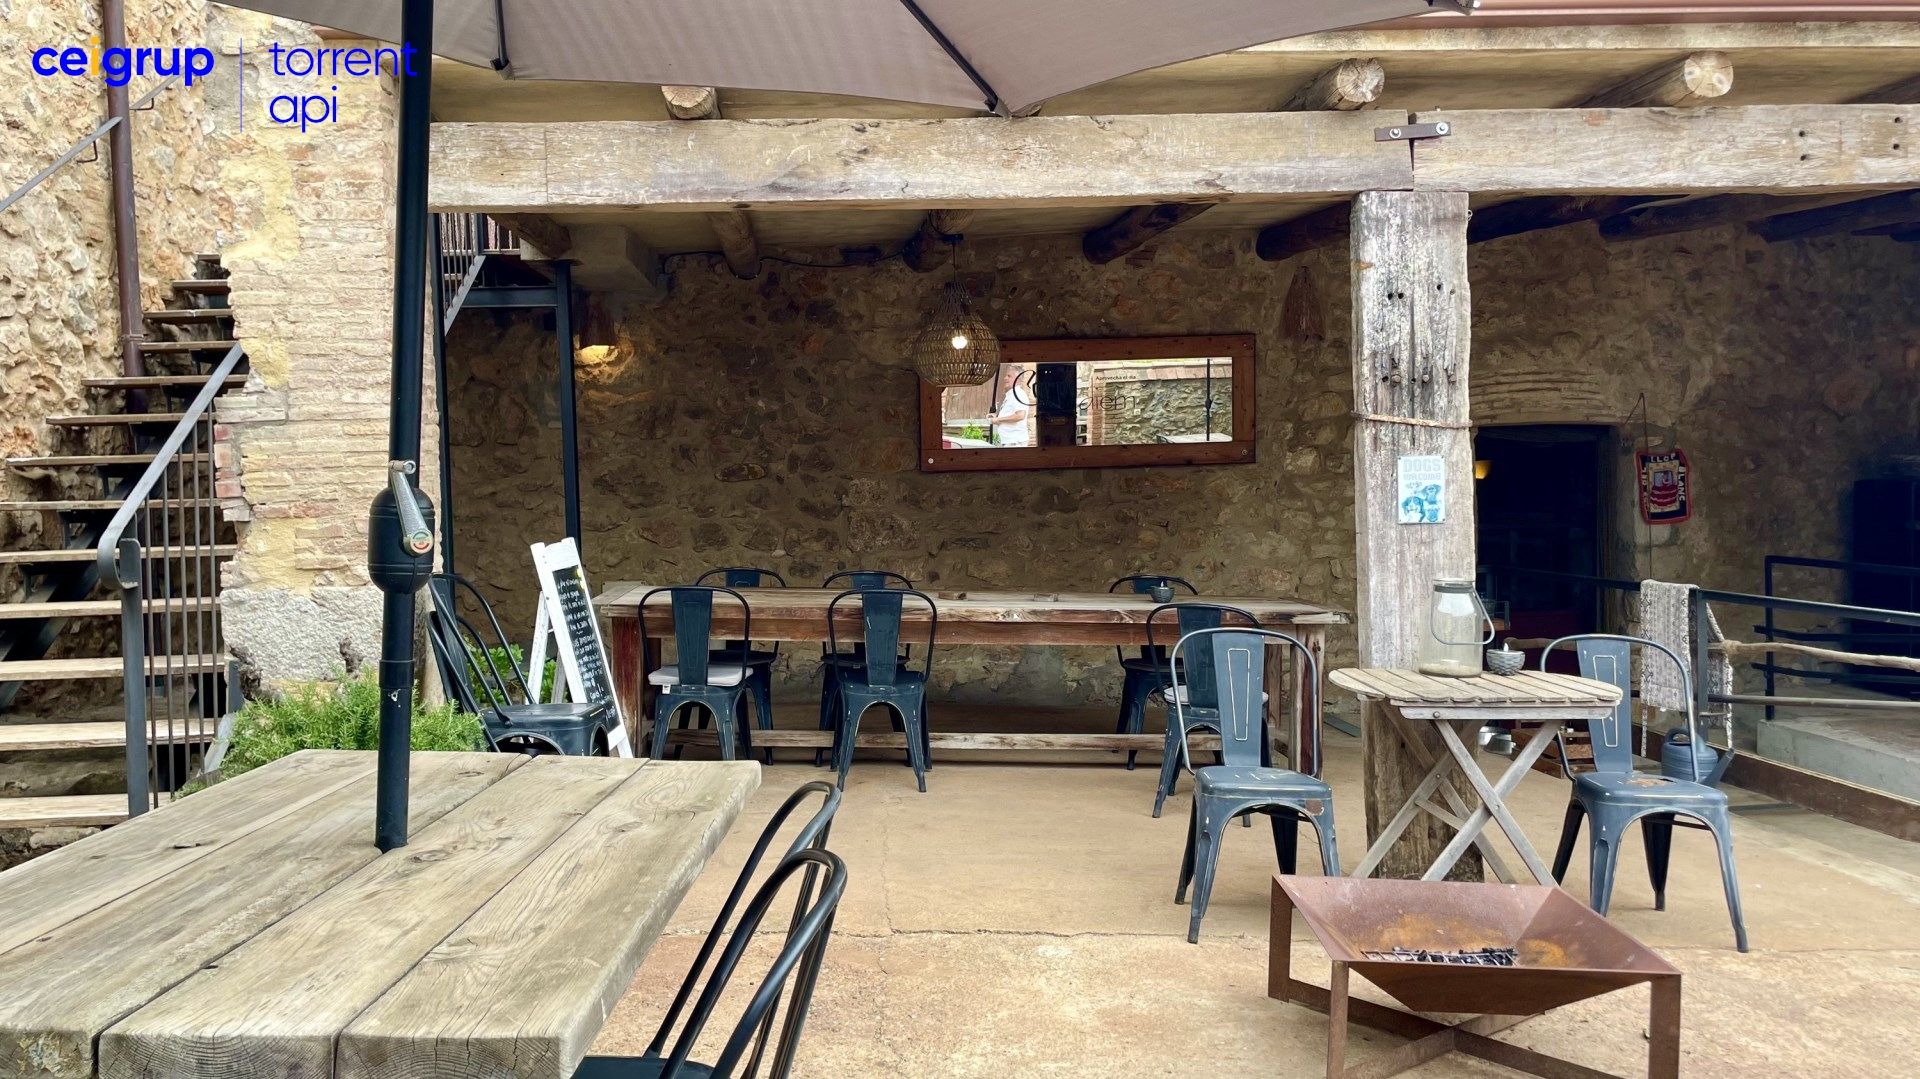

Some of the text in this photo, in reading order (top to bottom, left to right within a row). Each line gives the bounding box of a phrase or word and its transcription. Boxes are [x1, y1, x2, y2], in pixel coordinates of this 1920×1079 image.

[1403, 458, 1441, 473] DOGS
[1651, 453, 1676, 463] LLOP
[1678, 466, 1686, 501] BLANC
